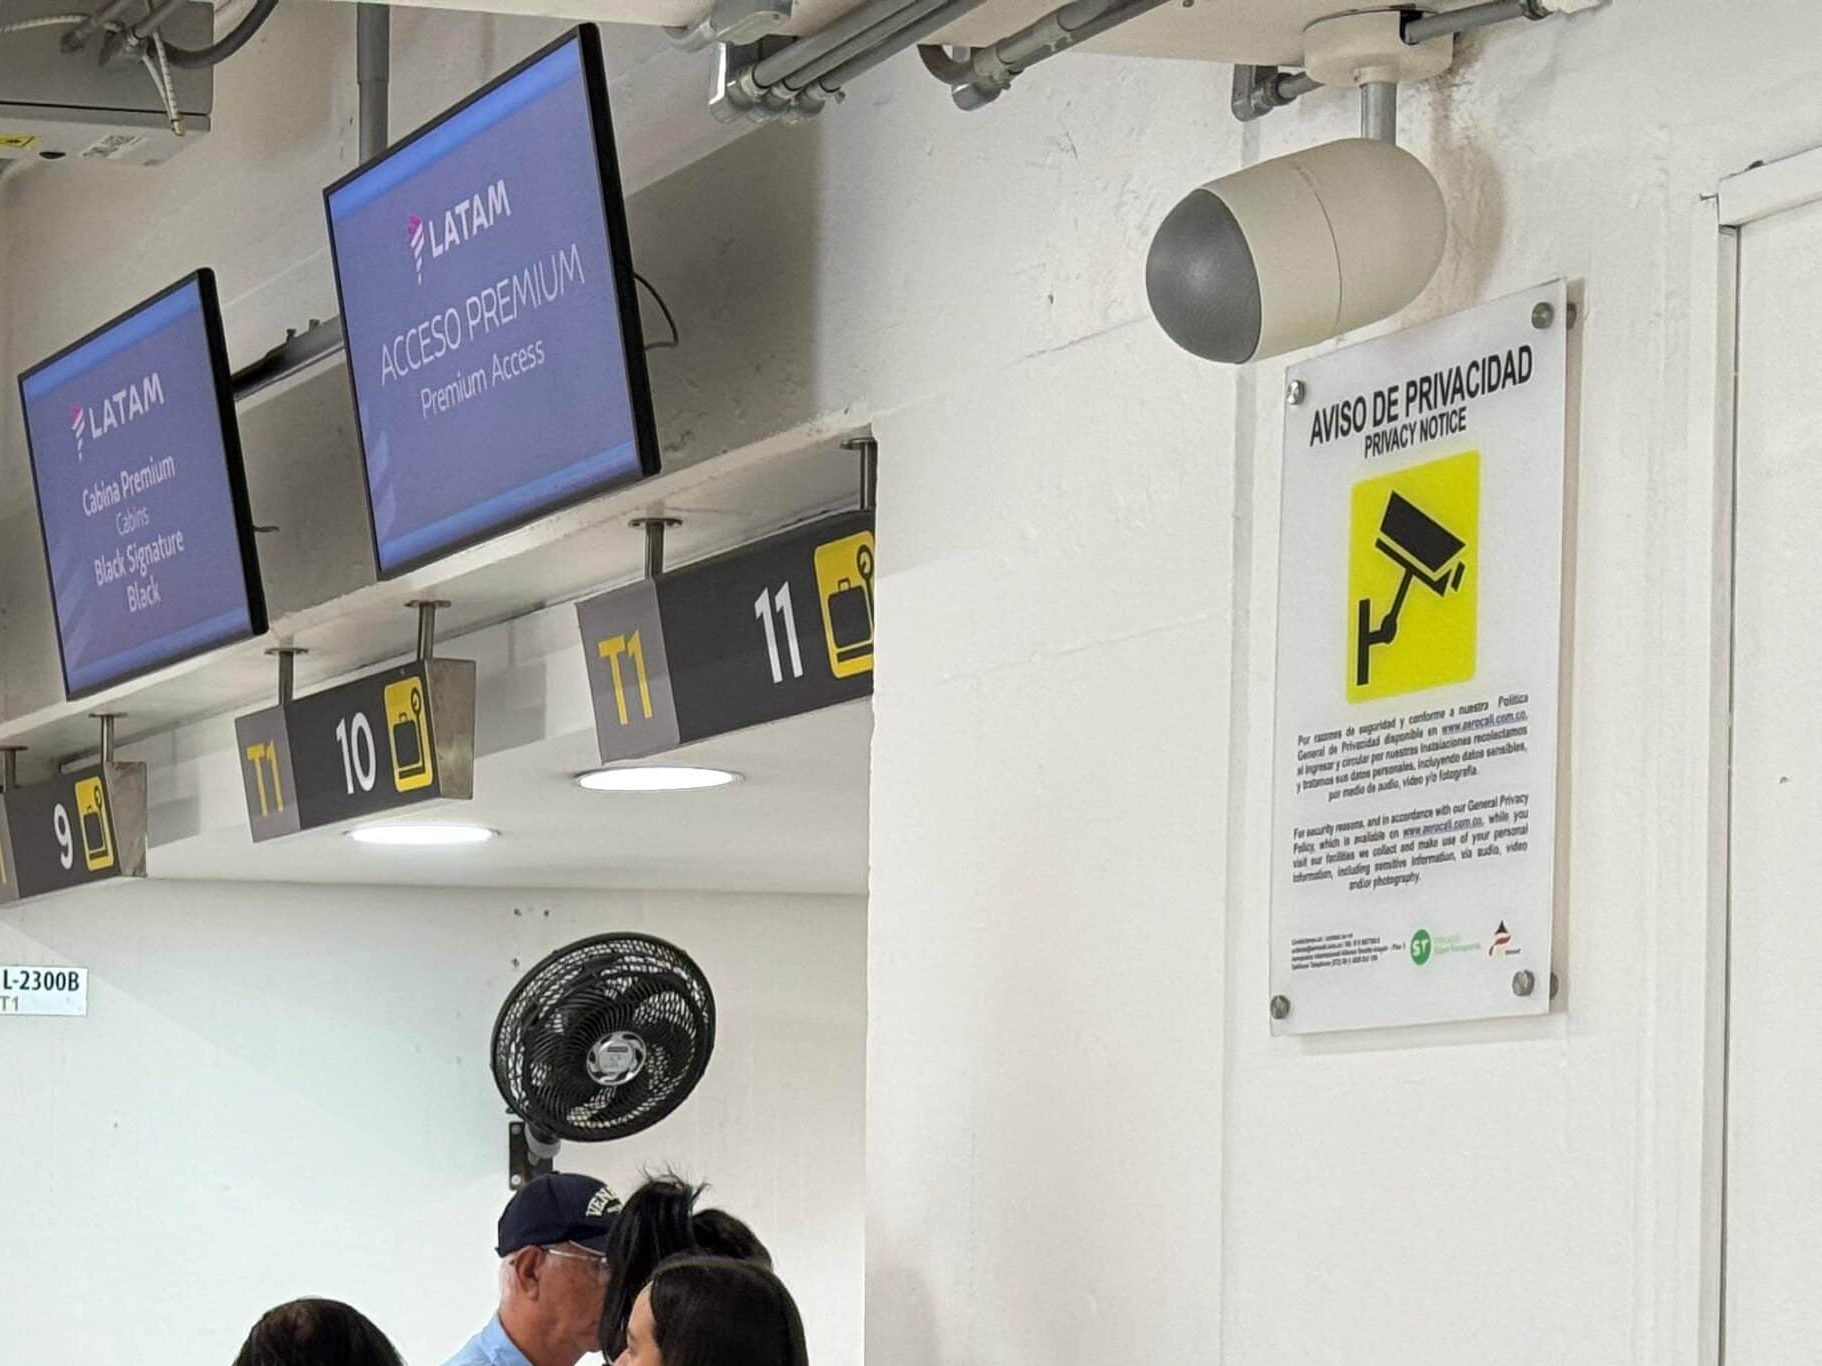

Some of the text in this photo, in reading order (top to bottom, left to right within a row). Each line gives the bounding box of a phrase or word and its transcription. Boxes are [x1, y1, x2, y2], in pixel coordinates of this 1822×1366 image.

[428, 179, 512, 259] LATAM
[381, 243, 586, 387] ACCESO PREMIUM
[88, 372, 165, 440] LATAM
[421, 340, 546, 420] Premium Access
[1309, 345, 1534, 447] AVISO DE PRIVACIDAD
[1364, 406, 1468, 459] PRIVACY NOTICE
[82, 455, 176, 518] Cabina Premium
[115, 506, 150, 537] Cabins
[94, 529, 184, 587] Black Signature
[127, 575, 162, 613] Black
[597, 580, 803, 725] T1 11
[246, 711, 376, 817] T1 10
[53, 803, 74, 870] 9
[0, 997, 20, 1012] T1
[3, 970, 80, 992] L-2300B
